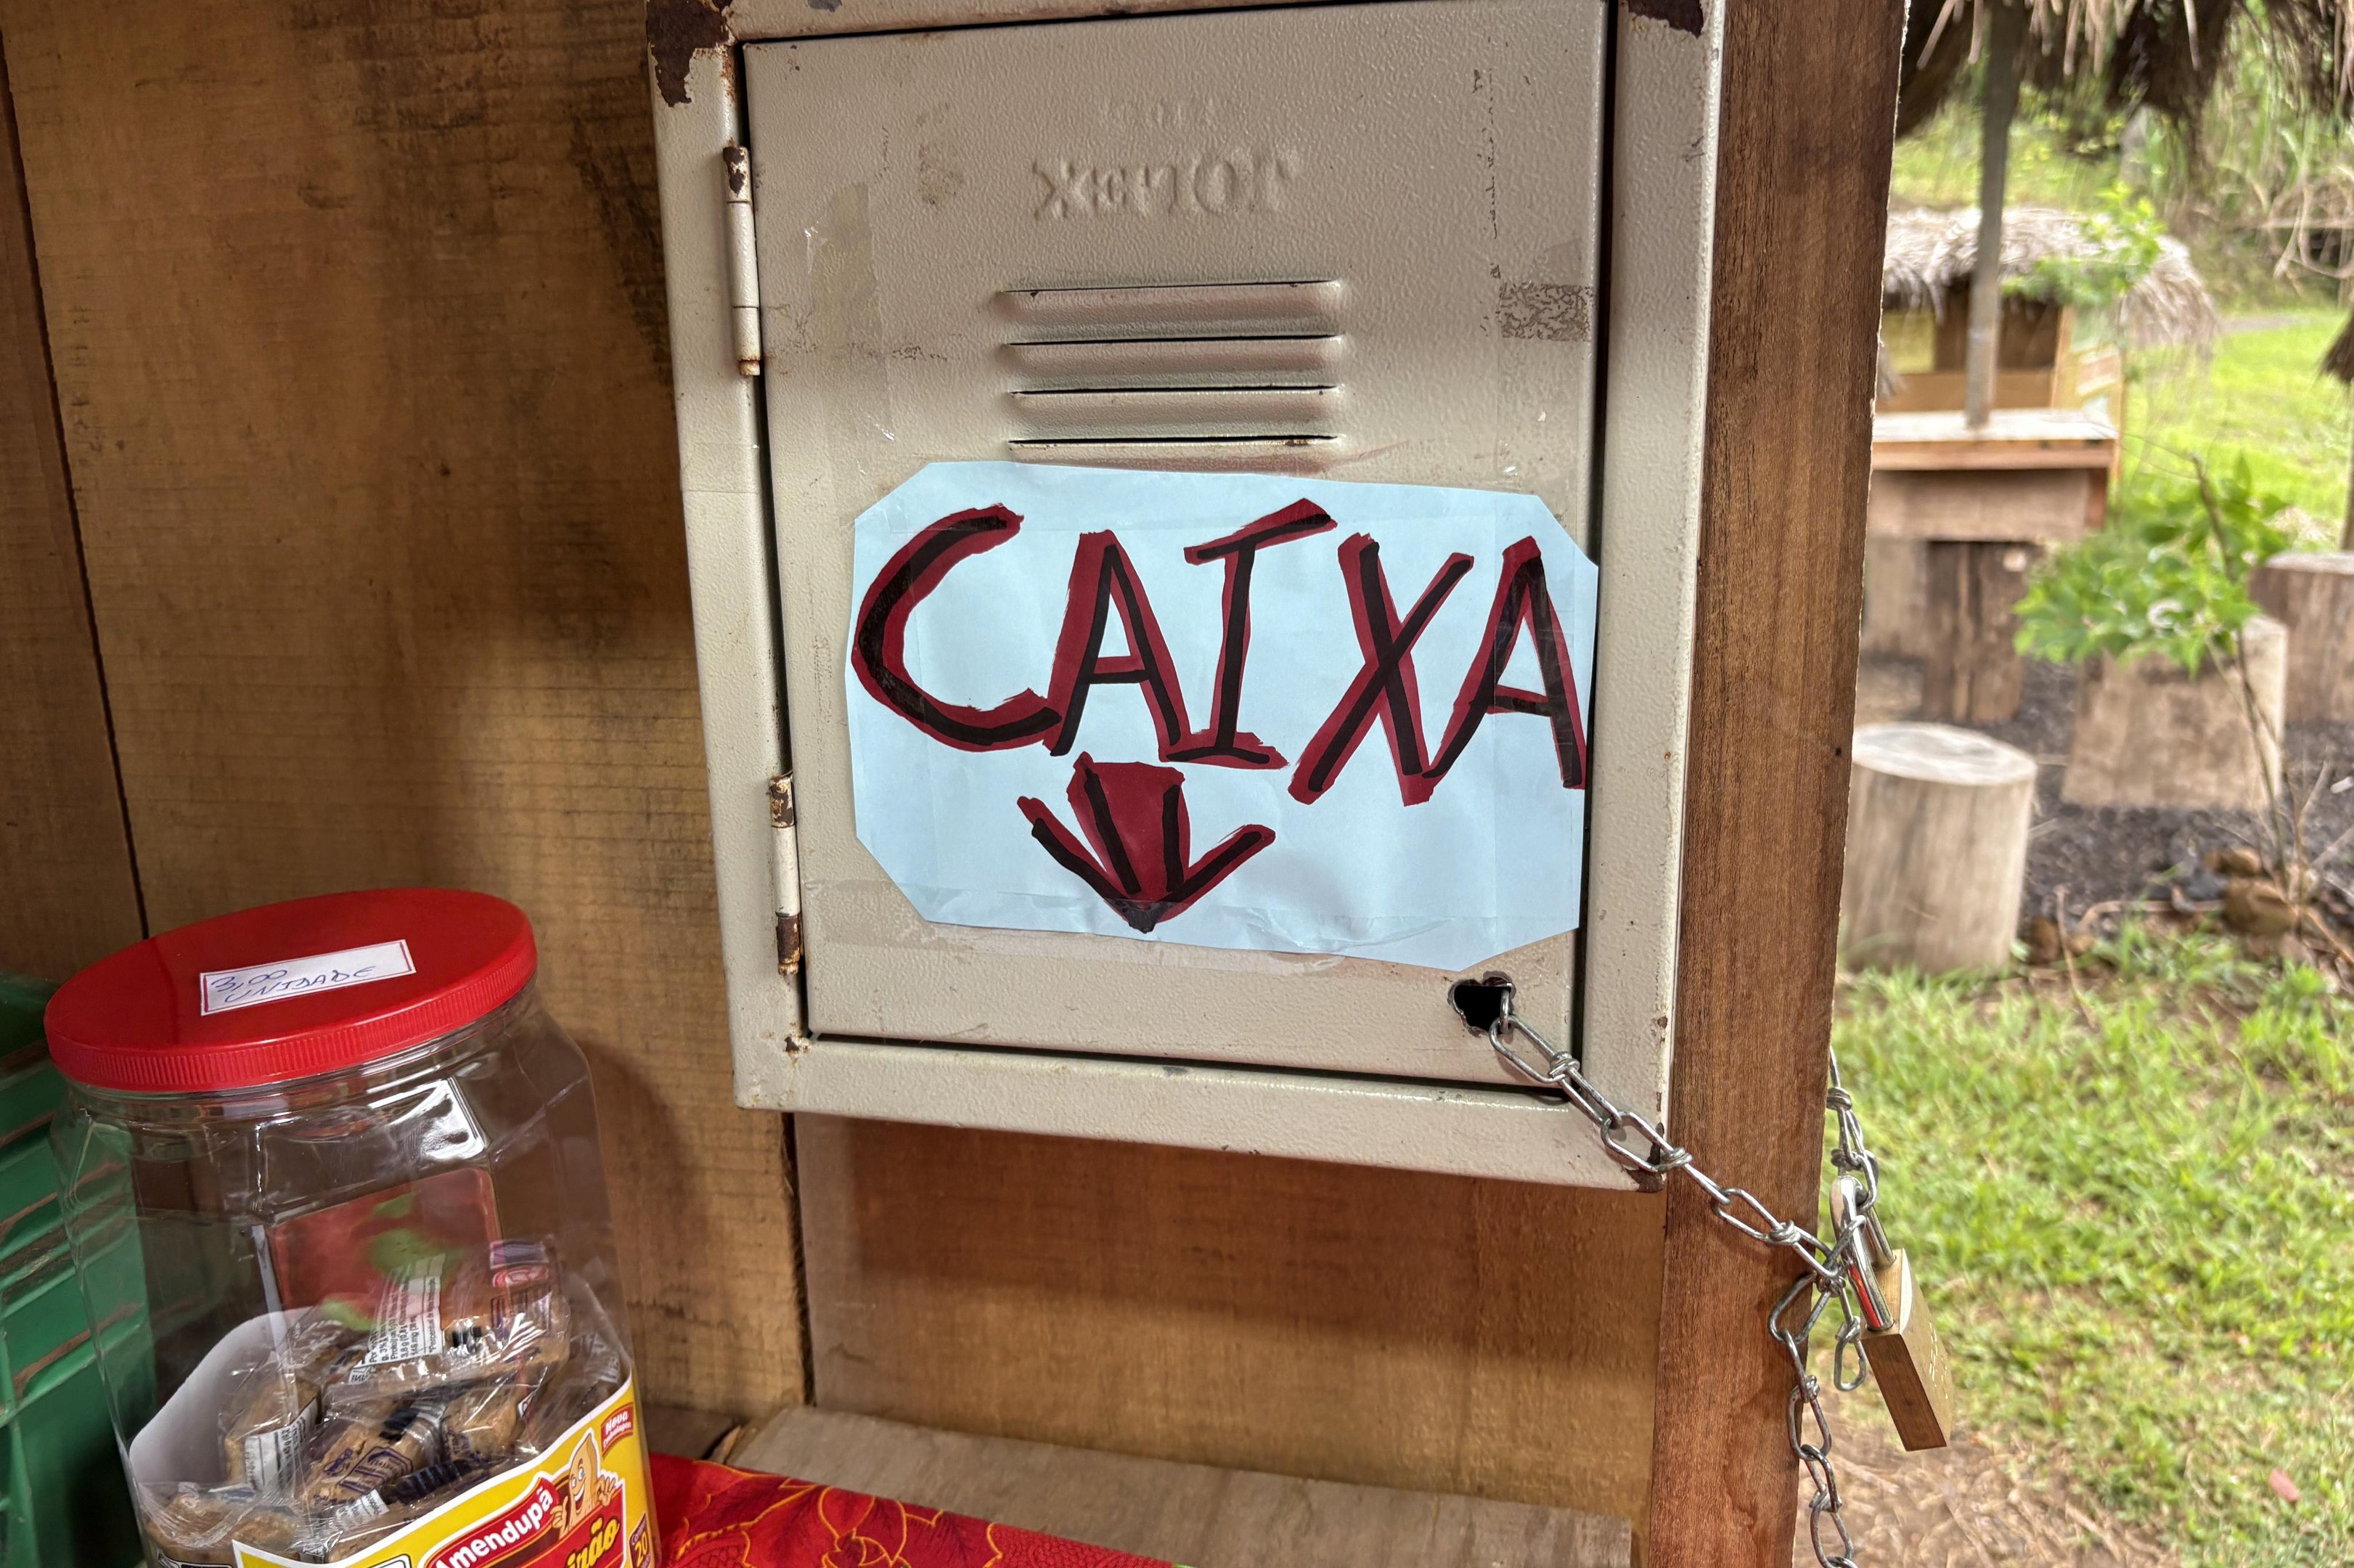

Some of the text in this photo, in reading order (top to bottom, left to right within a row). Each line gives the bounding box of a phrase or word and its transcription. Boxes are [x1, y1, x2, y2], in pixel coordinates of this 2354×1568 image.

[852, 499, 1585, 806] CAIXA
[211, 970, 287, 992] 3,00
[224, 966, 376, 1003] UNIDADE
